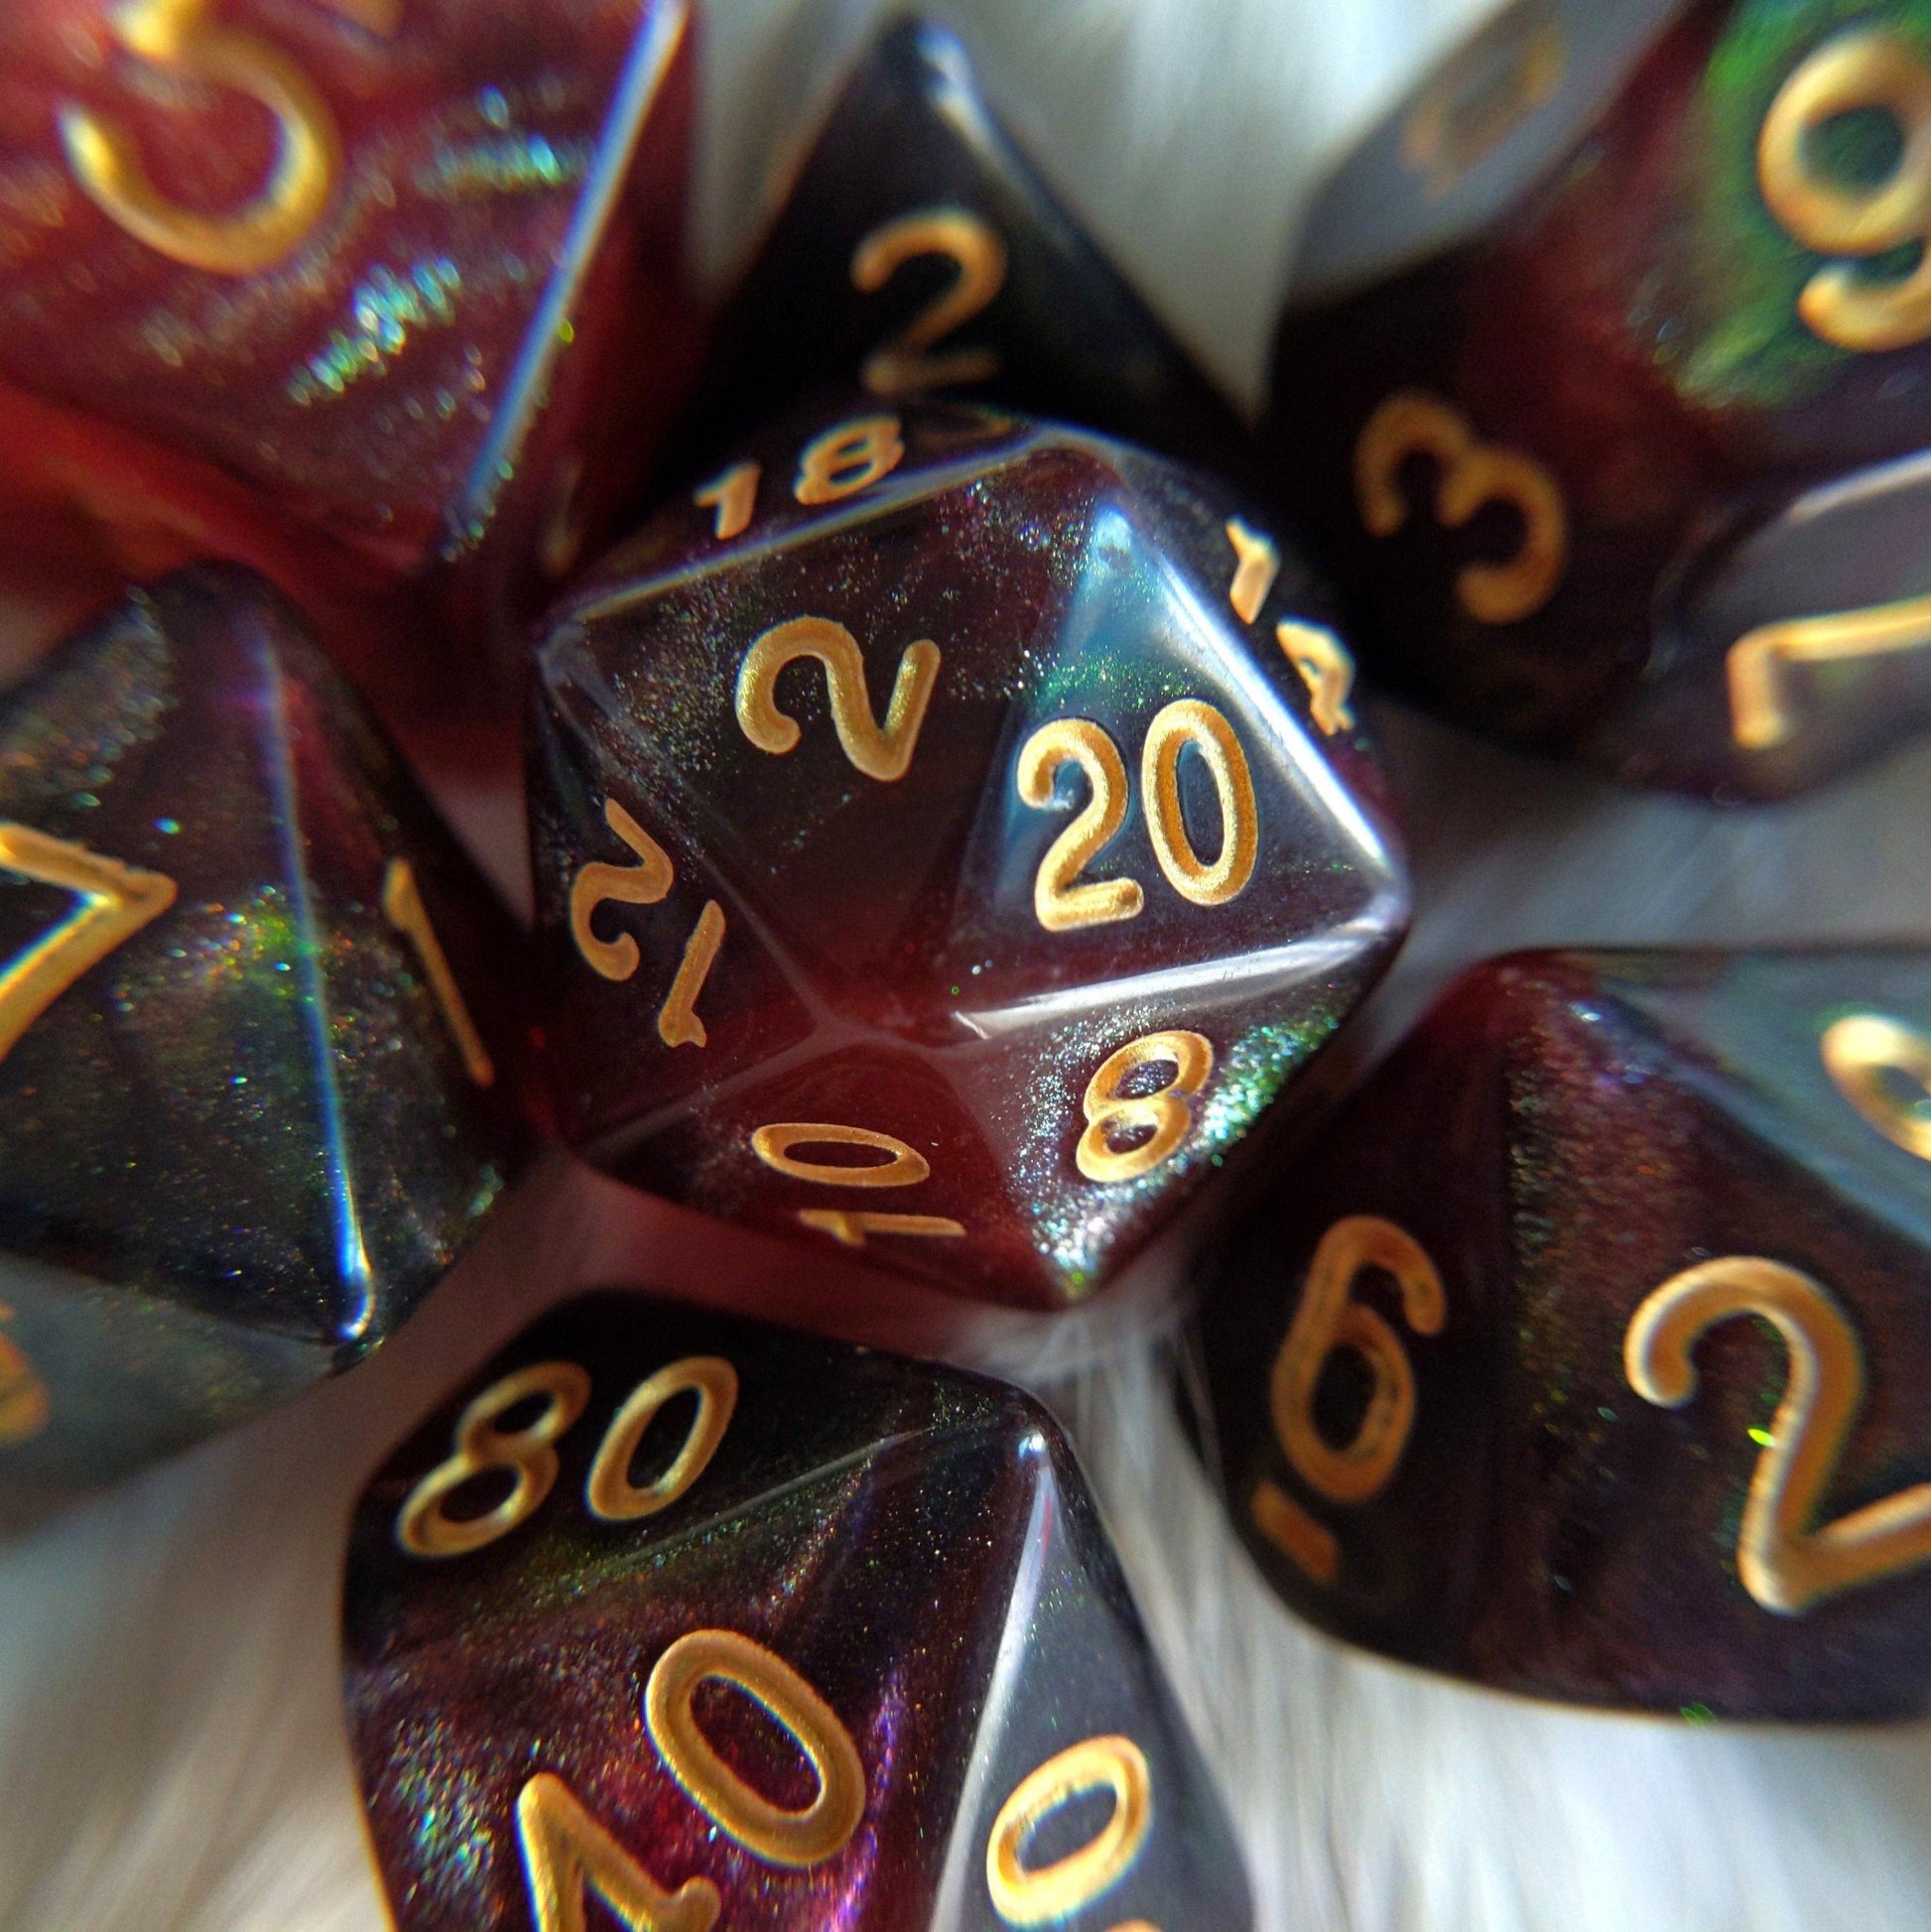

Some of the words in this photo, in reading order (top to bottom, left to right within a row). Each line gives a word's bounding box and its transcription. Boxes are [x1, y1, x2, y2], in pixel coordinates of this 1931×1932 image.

[1757, 24, 1931, 352] 9
[851, 205, 1008, 395] 2
[695, 414, 905, 540] 18
[1354, 388, 1567, 625] 3
[735, 614, 941, 782] 2
[1017, 698, 1258, 932] 20
[571, 798, 726, 1049] 12
[751, 1122, 966, 1246] 10
[1076, 1029, 1215, 1183] 8
[400, 1355, 738, 1559] 80
[1623, 1255, 1931, 1617] 2
